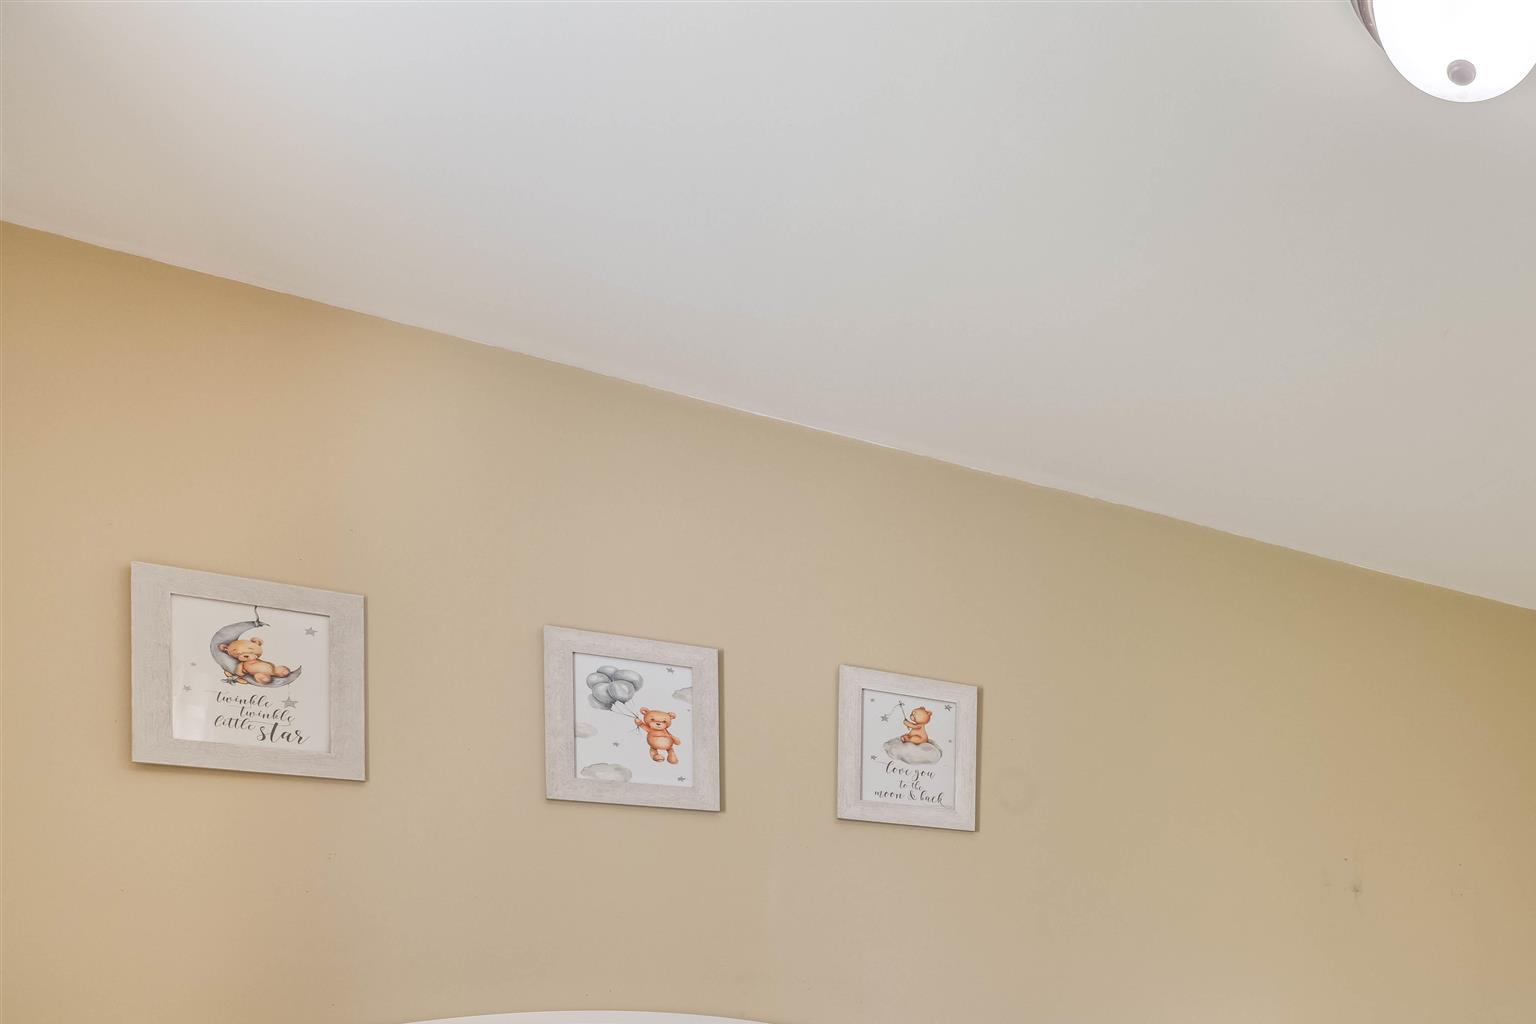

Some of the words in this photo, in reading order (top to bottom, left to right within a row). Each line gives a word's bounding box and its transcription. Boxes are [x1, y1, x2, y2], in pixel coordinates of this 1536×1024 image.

[216, 691, 272, 707] twinkle
[240, 706, 295, 722] twinkle
[214, 715, 255, 730] little
[257, 722, 310, 744] star
[886, 760, 911, 775] love
[914, 769, 935, 782] you
[899, 780, 907, 789] to
[874, 790, 902, 799] moon
[920, 790, 945, 807] back
